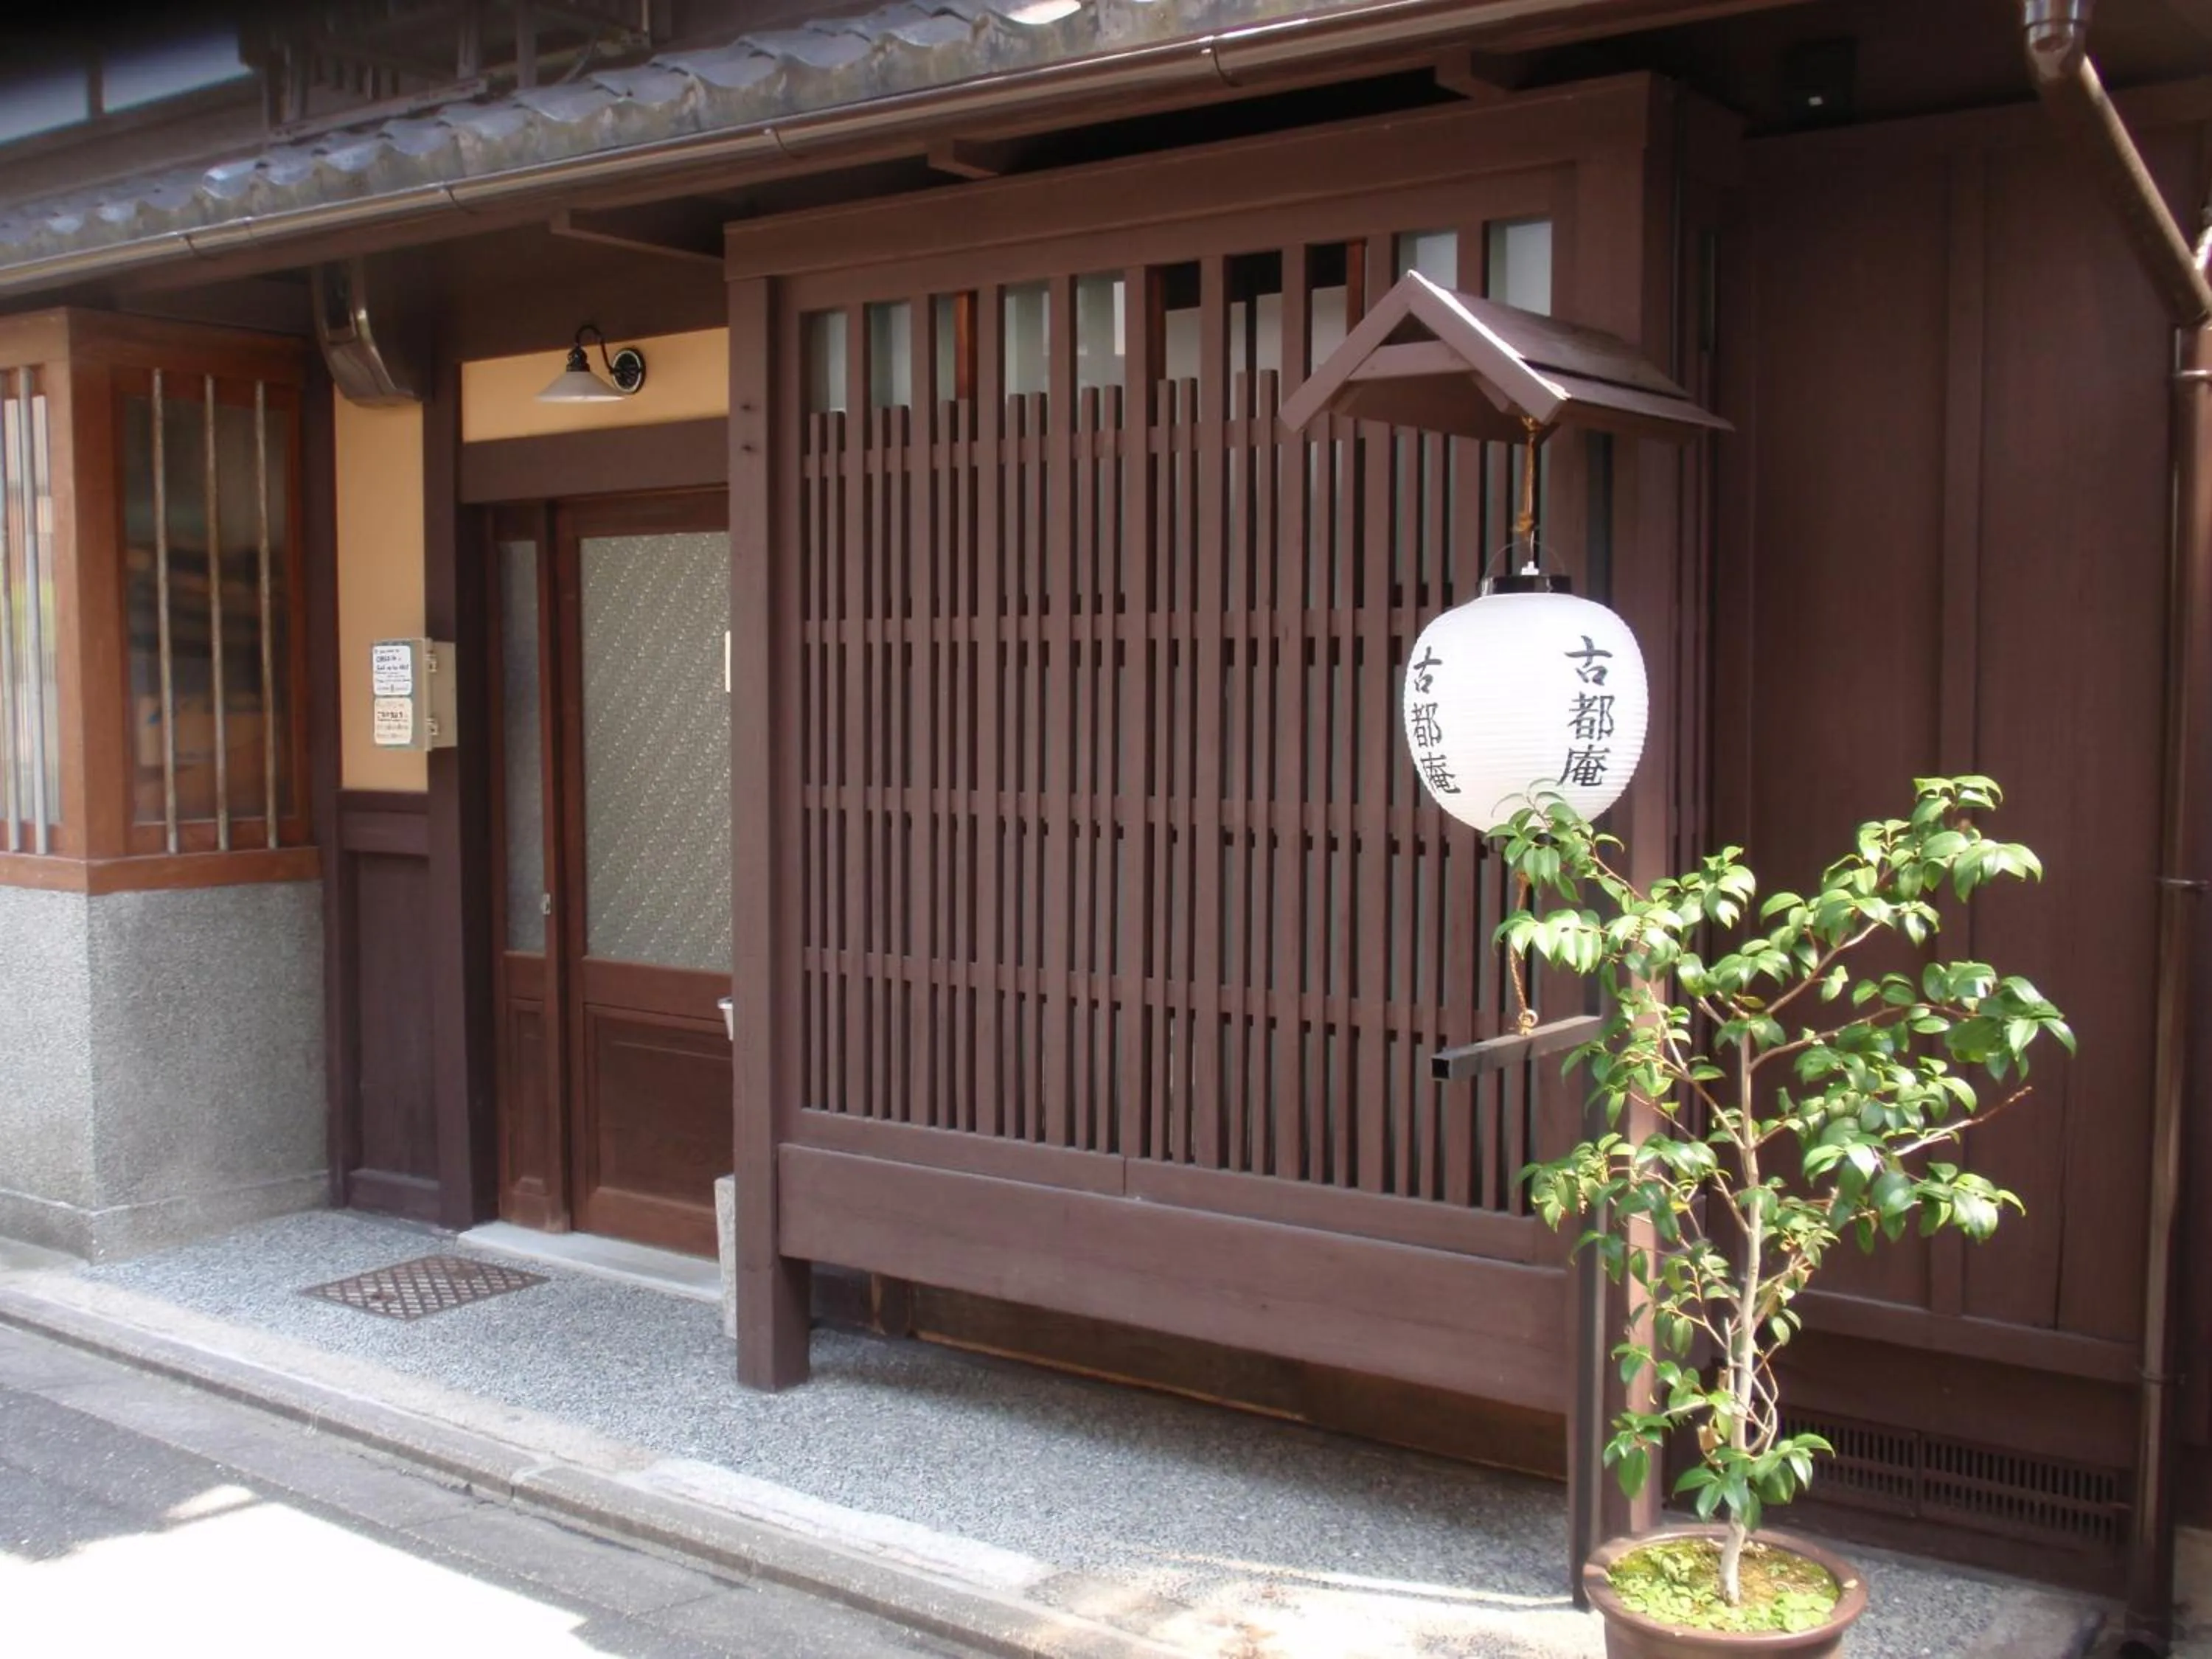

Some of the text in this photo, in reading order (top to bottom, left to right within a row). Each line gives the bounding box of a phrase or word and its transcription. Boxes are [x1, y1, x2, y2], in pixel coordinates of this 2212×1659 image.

[1411, 646, 1461, 794] 古都庵
[1557, 635, 1615, 787] 古都庵
